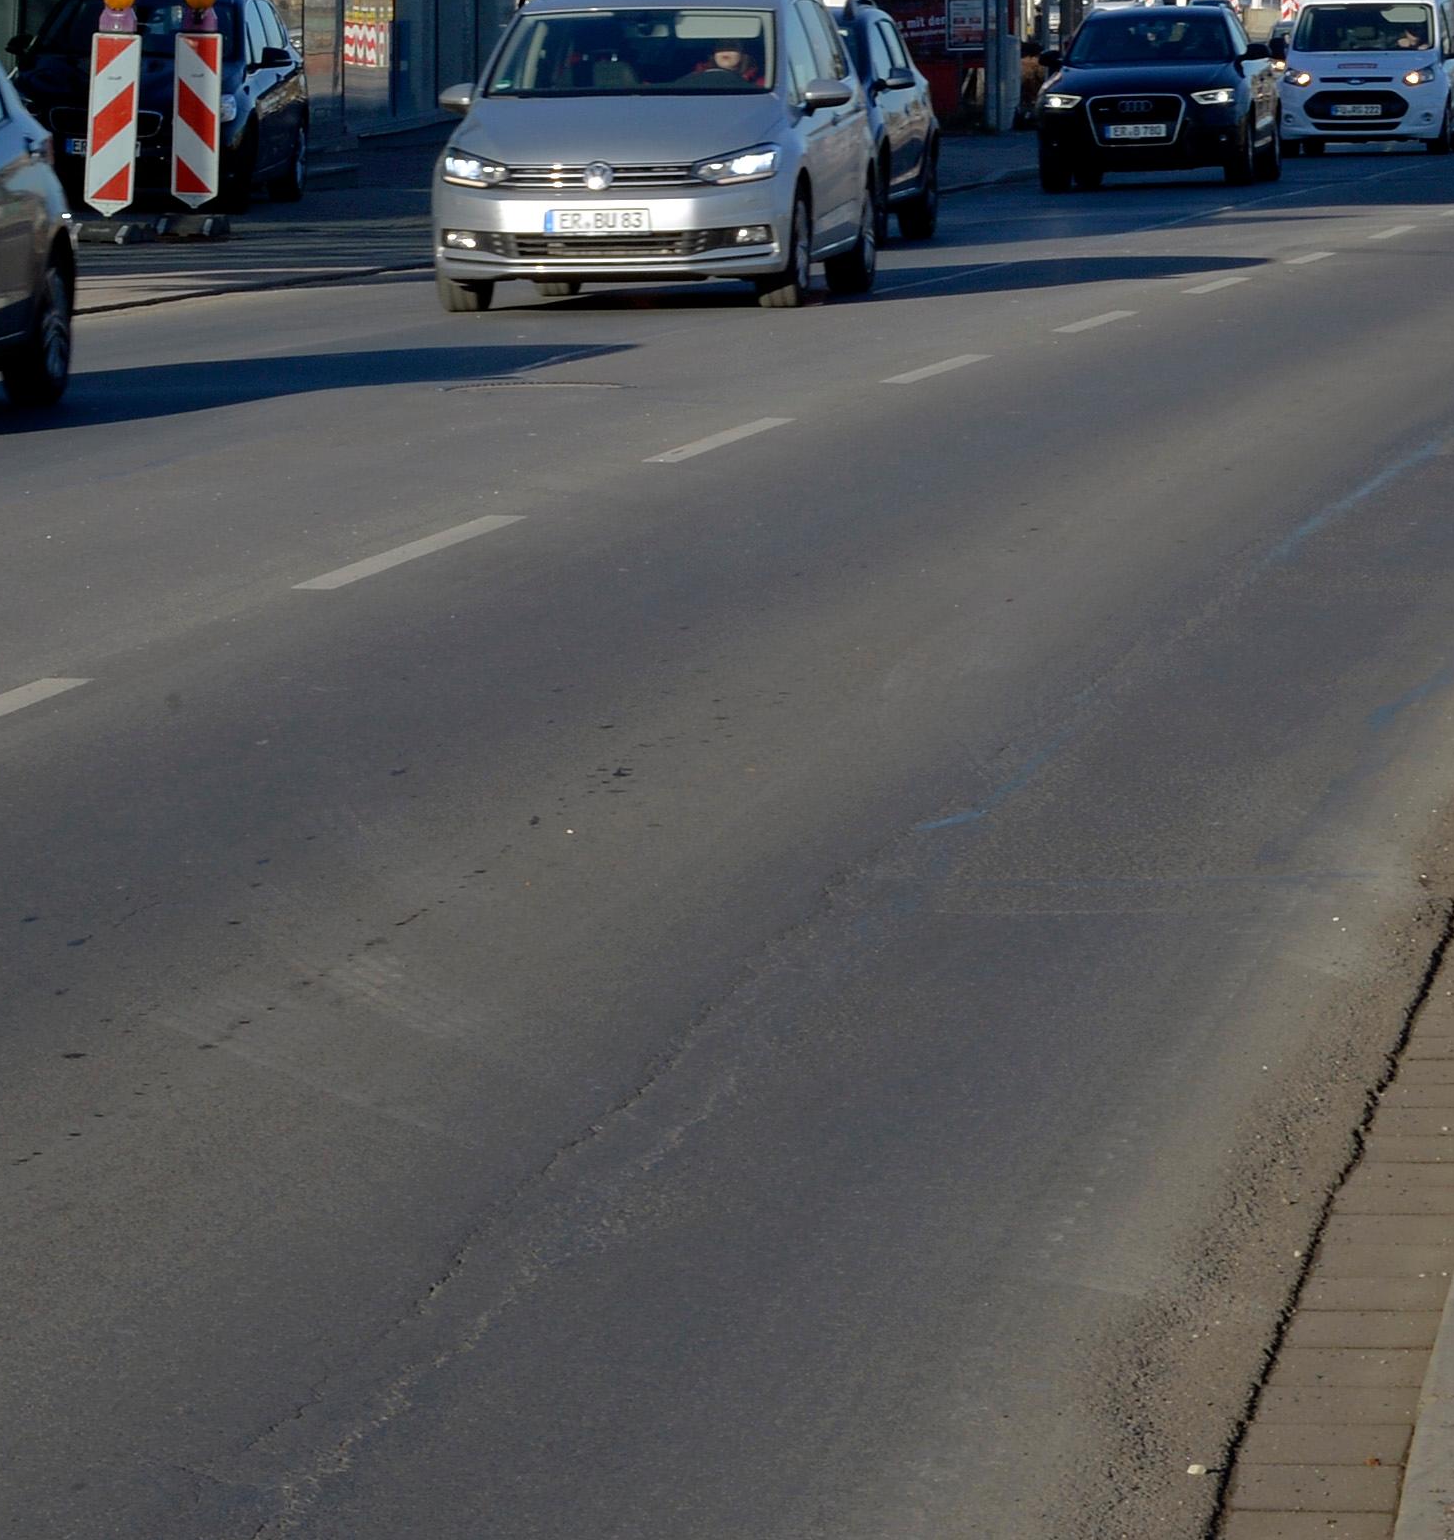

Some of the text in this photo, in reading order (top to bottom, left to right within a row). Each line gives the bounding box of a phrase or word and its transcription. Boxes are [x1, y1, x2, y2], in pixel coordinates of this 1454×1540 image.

[560, 212, 643, 229] ER BU 83
